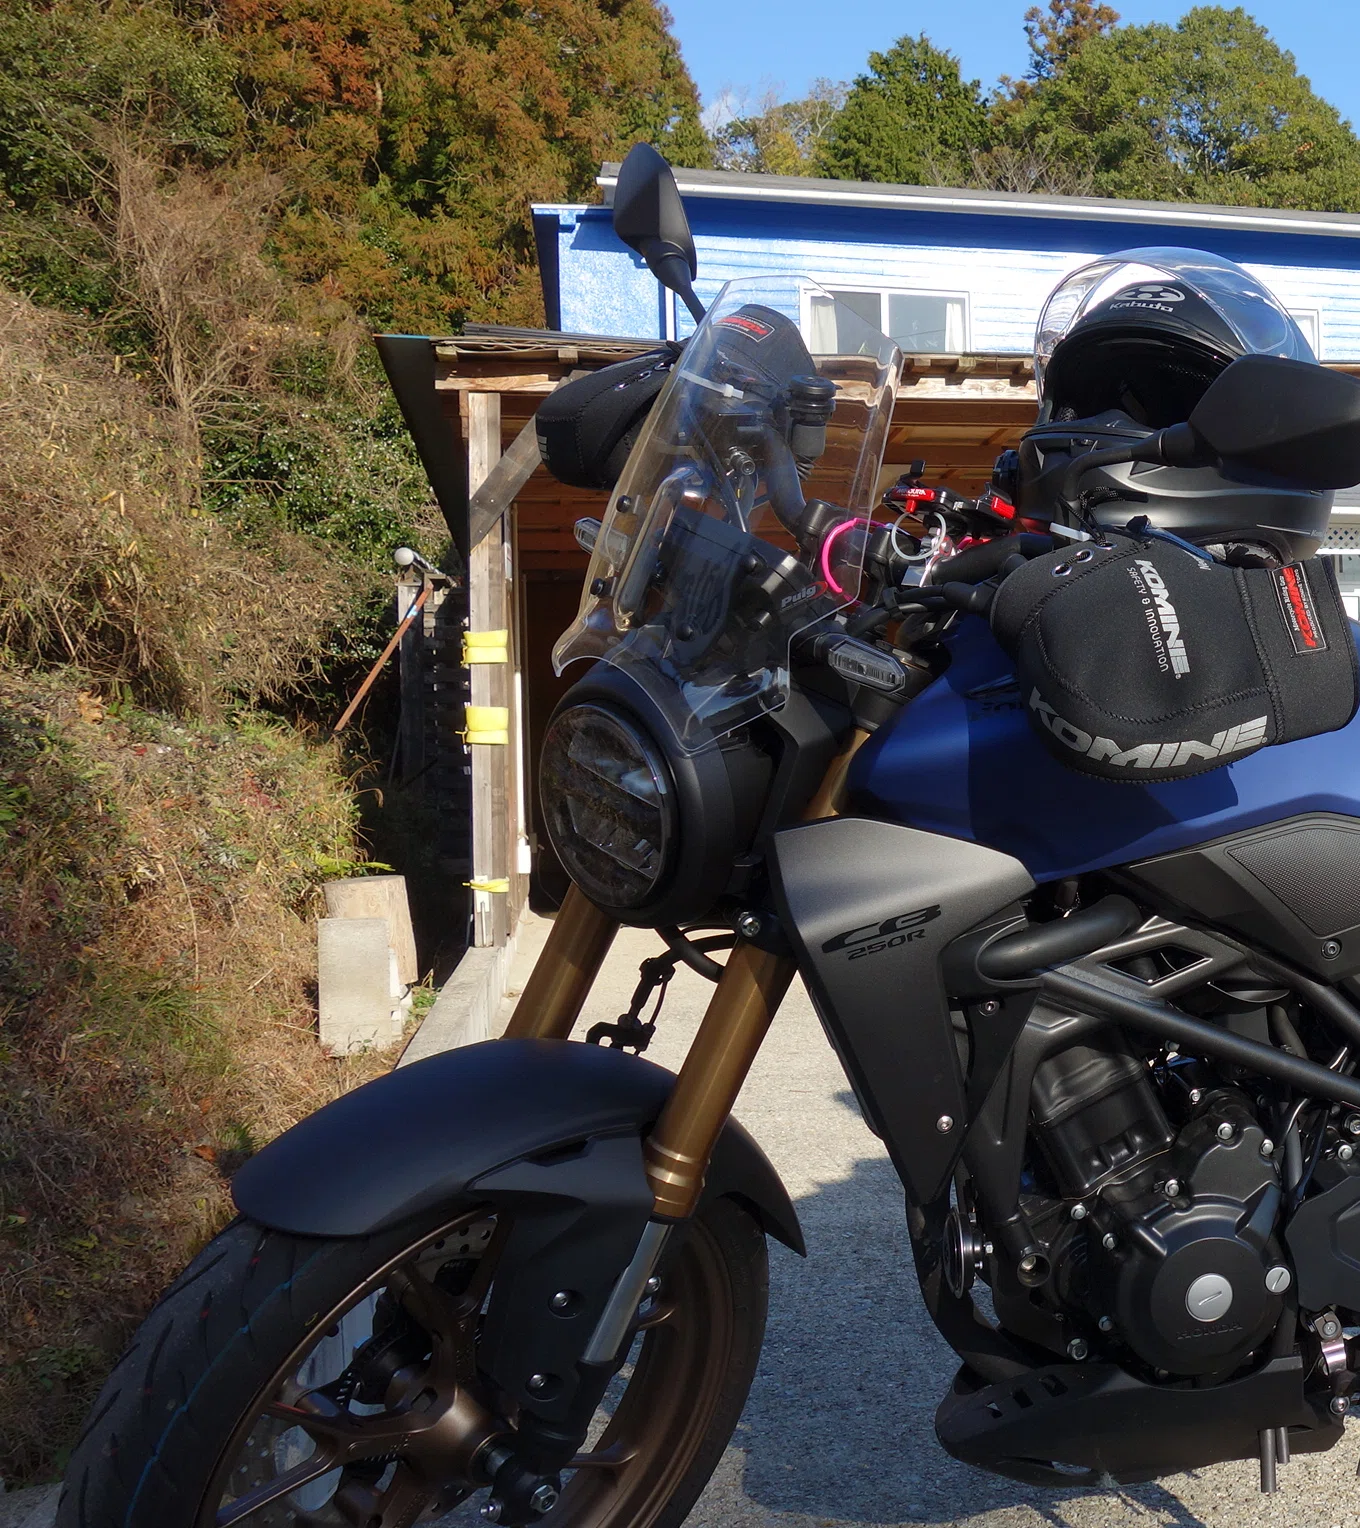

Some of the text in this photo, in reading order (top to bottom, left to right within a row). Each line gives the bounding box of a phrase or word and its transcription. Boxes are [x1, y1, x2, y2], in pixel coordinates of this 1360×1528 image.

[1109, 301, 1174, 313] Kabuto
[781, 585, 817, 608] Puig
[1127, 567, 1147, 594] SAFETY
[1145, 607, 1169, 673] INNOVATION
[1134, 559, 1190, 675] KOMINE
[1282, 567, 1317, 647] KOMINE
[1029, 686, 1268, 769] KOMINE
[822, 904, 942, 954] CB
[846, 928, 927, 961] 250R
